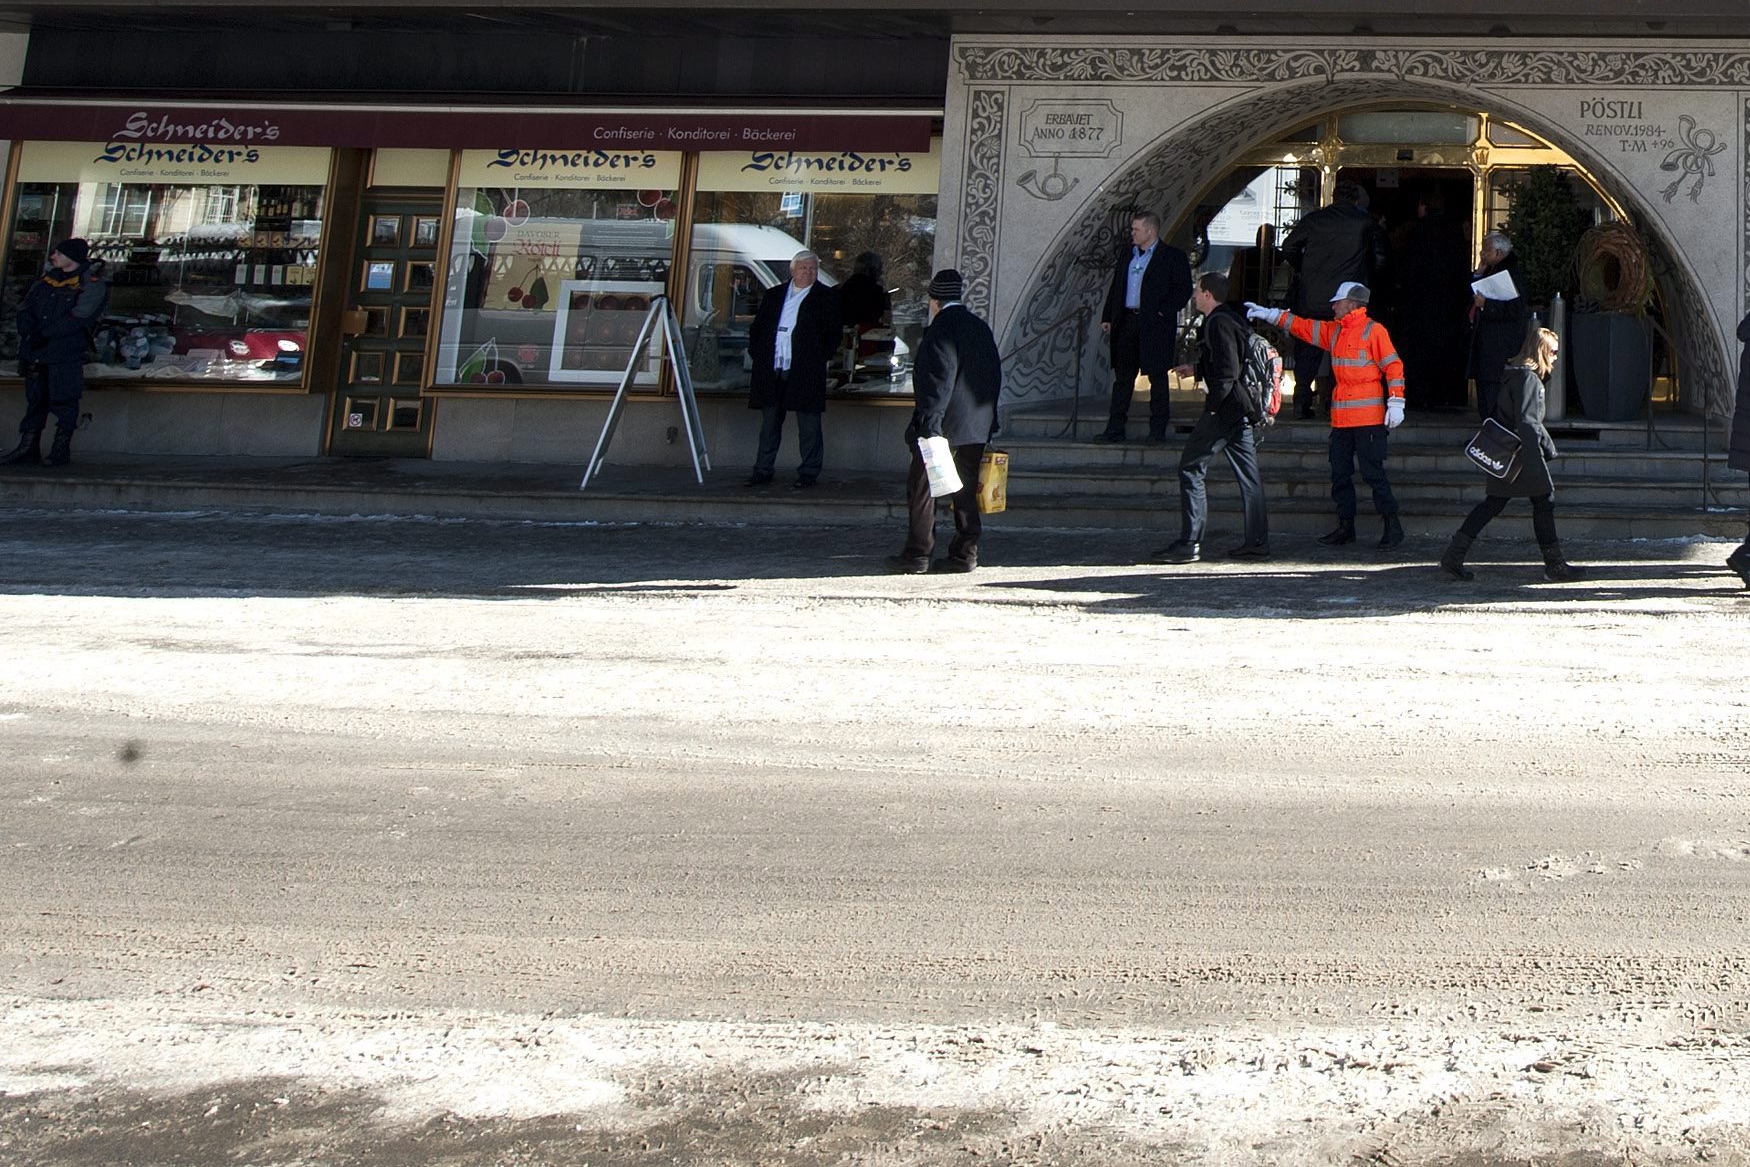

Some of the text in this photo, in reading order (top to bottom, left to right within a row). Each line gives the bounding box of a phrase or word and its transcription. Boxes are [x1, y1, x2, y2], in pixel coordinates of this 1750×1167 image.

[1580, 97, 1642, 120] PÖSTLI
[112, 111, 280, 141] Schneider's
[594, 127, 797, 141] Confiserie Konditorei Bäckerei
[1031, 126, 1104, 143] ANNO 1877
[120, 168, 154, 177] Confiserie
[160, 168, 195, 177] Konditorei
[514, 173, 549, 181] Confiserie
[555, 173, 590, 182] Konditorei
[769, 177, 804, 185] Confiserie
[810, 177, 846, 185] Konditorei
[1469, 446, 1493, 466] adidas
